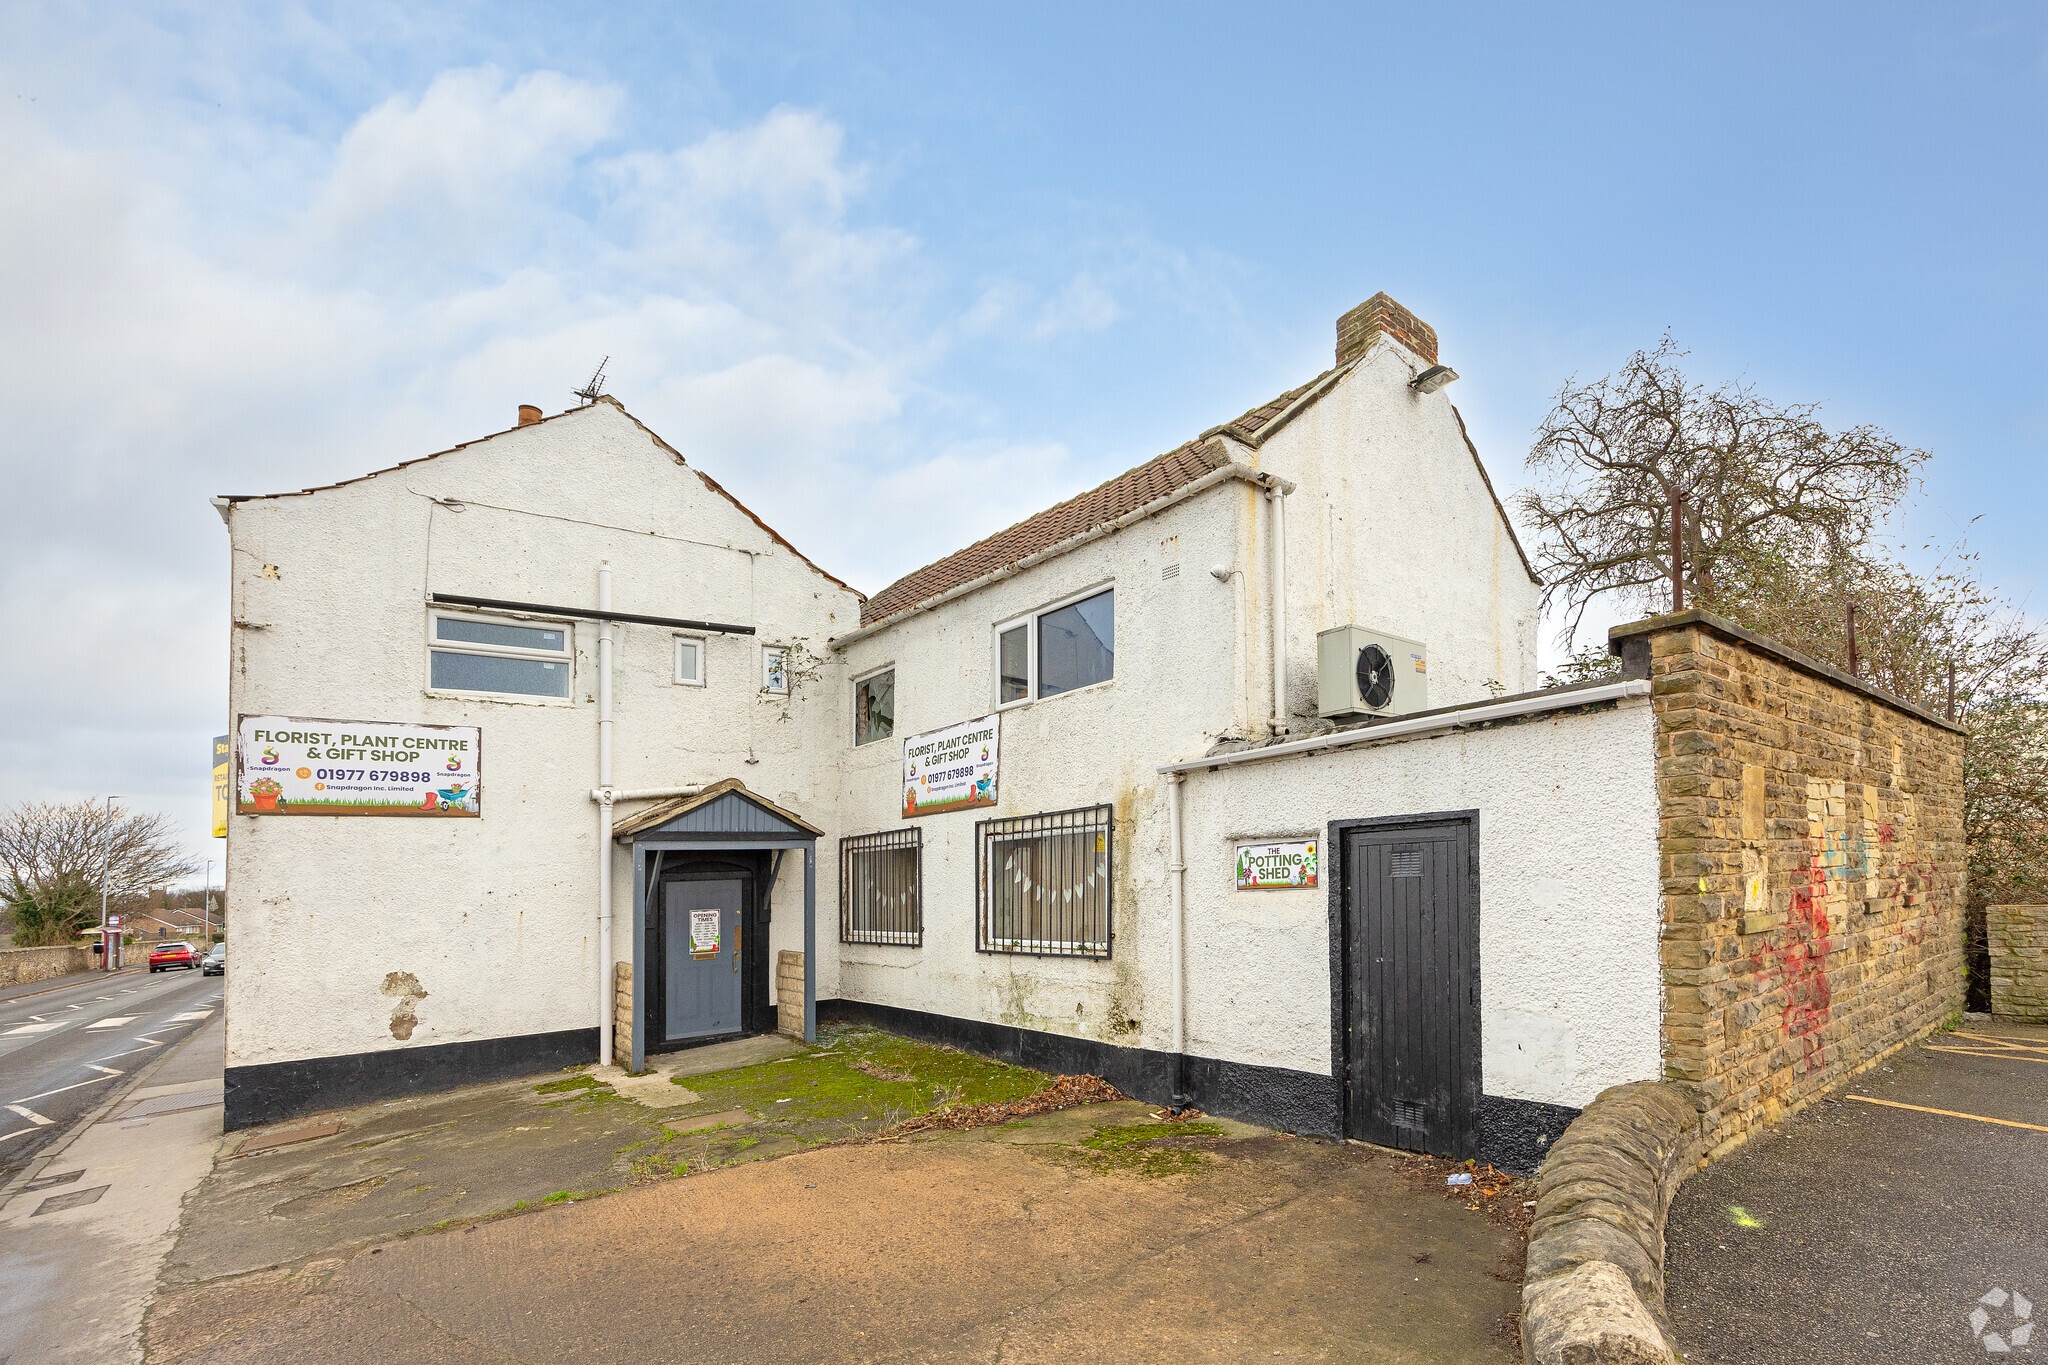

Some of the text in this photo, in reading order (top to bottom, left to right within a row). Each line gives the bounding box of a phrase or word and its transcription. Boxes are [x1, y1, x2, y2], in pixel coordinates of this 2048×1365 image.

[254, 729, 468, 751] FLORIST, PLANT CENTRE
[908, 728, 994, 758] FLORIST, PLANT CENTRE
[306, 747, 420, 763] & GIFT SHOP
[924, 747, 970, 767] & GIFT SHOP
[316, 768, 431, 783] 01977 679898
[927, 765, 974, 784] 01977 679898
[326, 784, 373, 792] Snapdragon
[1268, 847, 1280, 855] THE
[1248, 853, 1302, 868] POTTING
[1258, 867, 1291, 880] SHED
